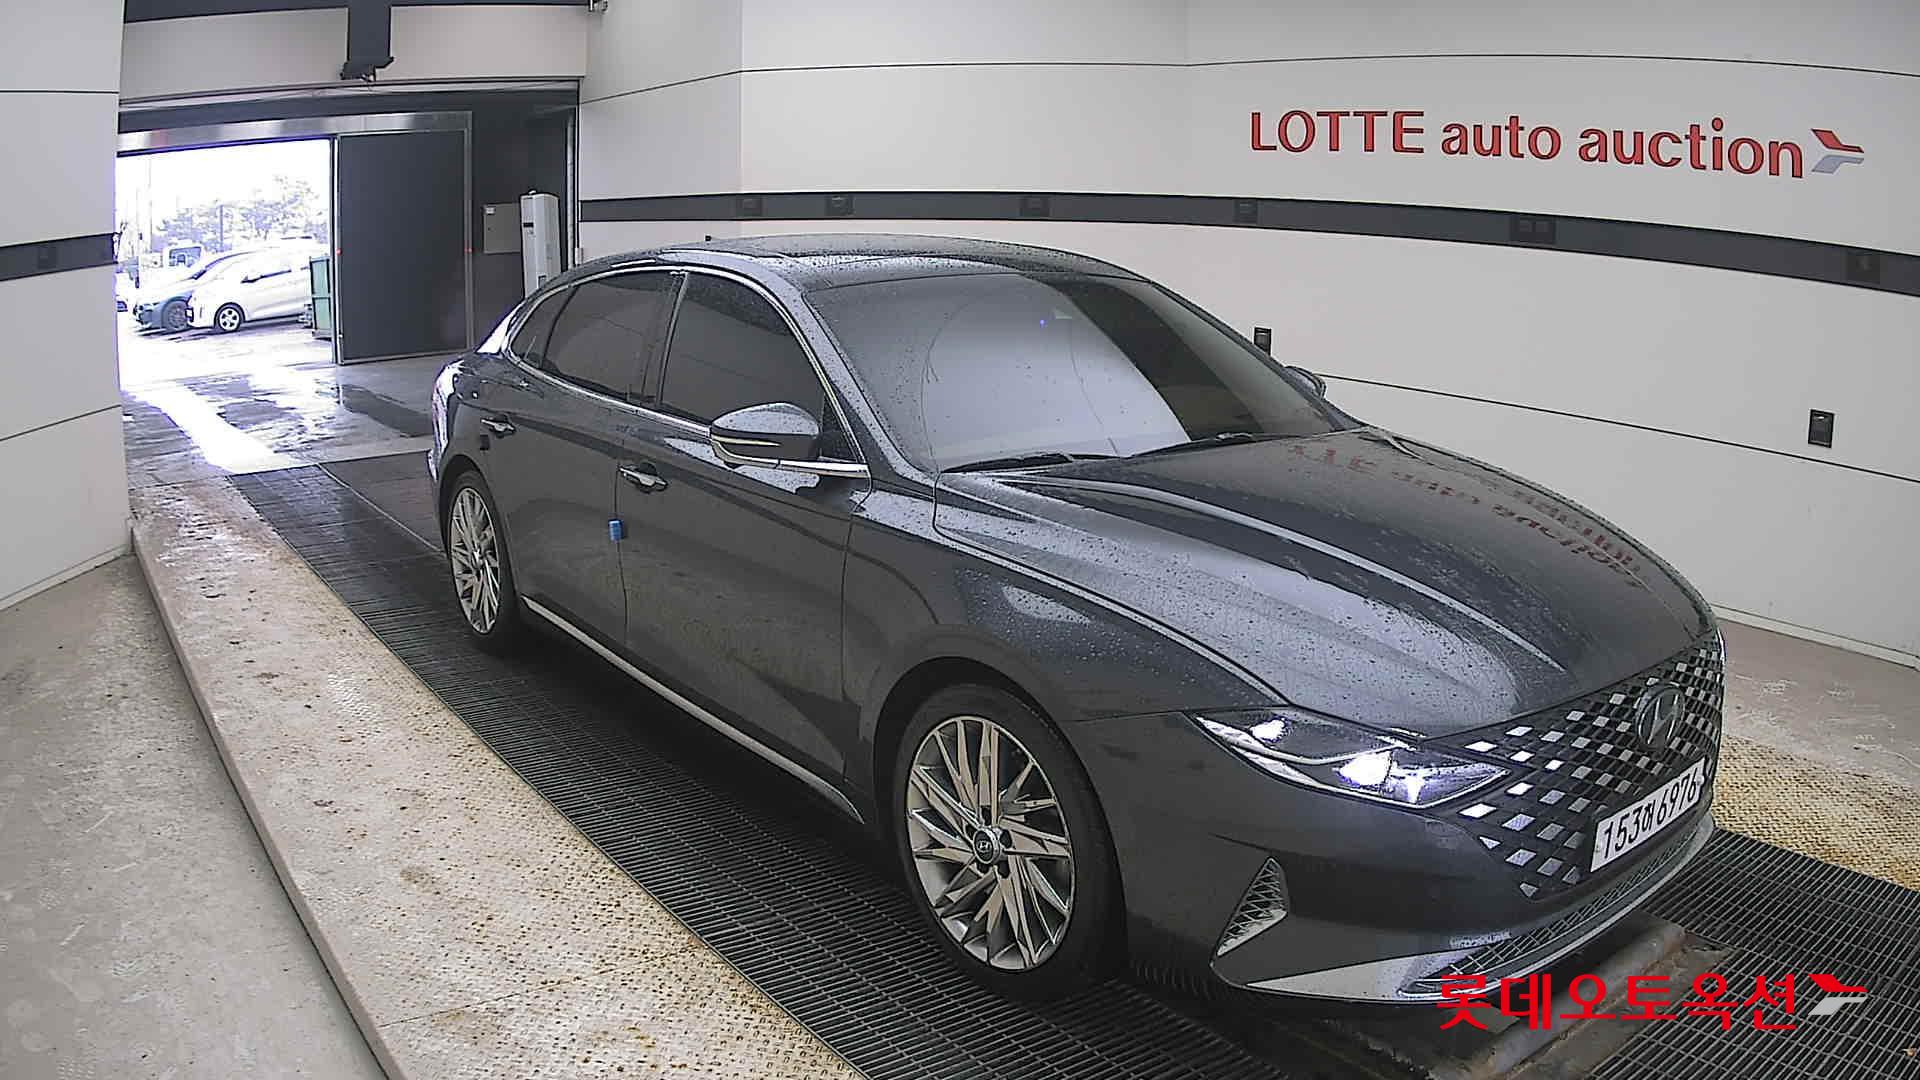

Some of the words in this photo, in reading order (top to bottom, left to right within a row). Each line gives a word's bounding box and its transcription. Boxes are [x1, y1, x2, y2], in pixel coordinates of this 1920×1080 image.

[1250, 110, 1425, 154] LOTTE
[1441, 115, 1562, 160] auto
[1577, 117, 1804, 179] auction
